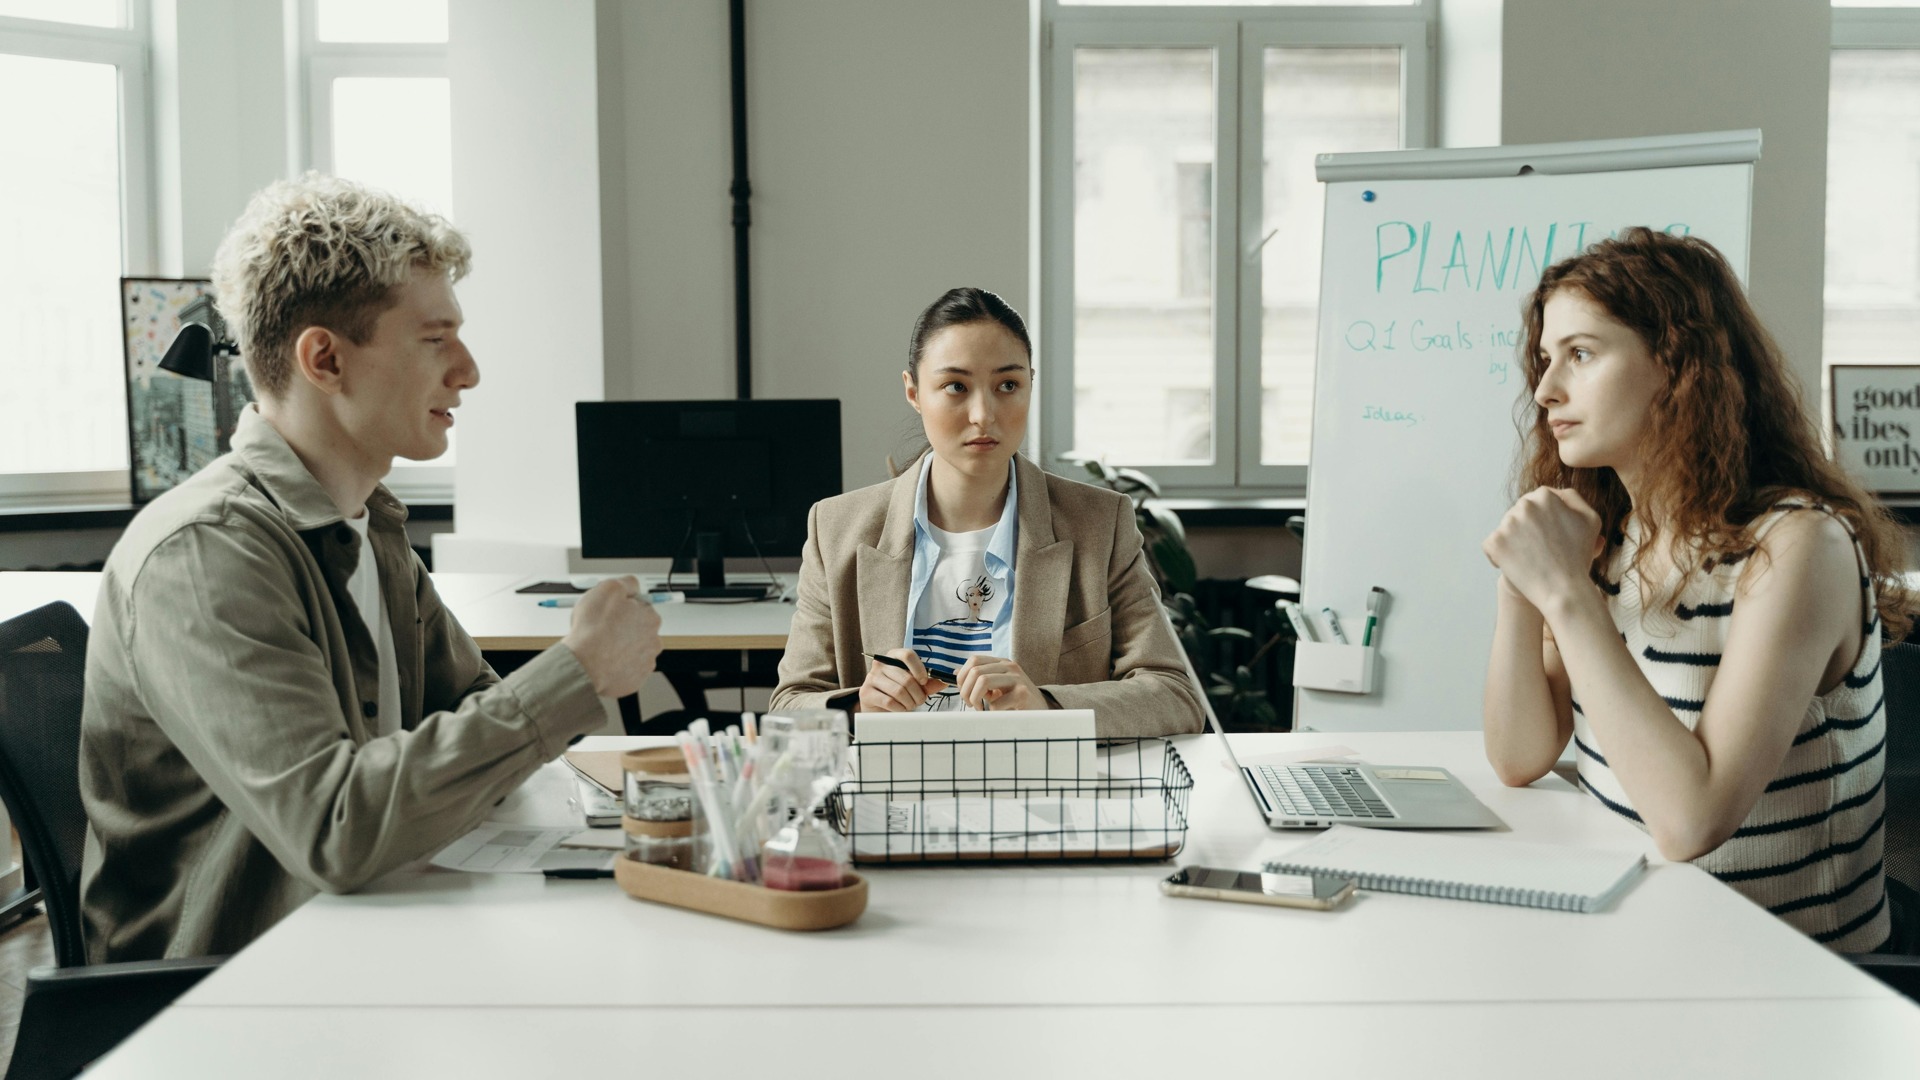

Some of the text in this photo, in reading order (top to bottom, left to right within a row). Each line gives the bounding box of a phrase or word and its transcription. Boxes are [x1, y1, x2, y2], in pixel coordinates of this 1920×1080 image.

[1375, 221, 1691, 293] PLANN
[1344, 320, 1396, 352] Q1
[1489, 323, 1523, 348] inc
[1487, 353, 1508, 385] by
[1853, 383, 1920, 416] good
